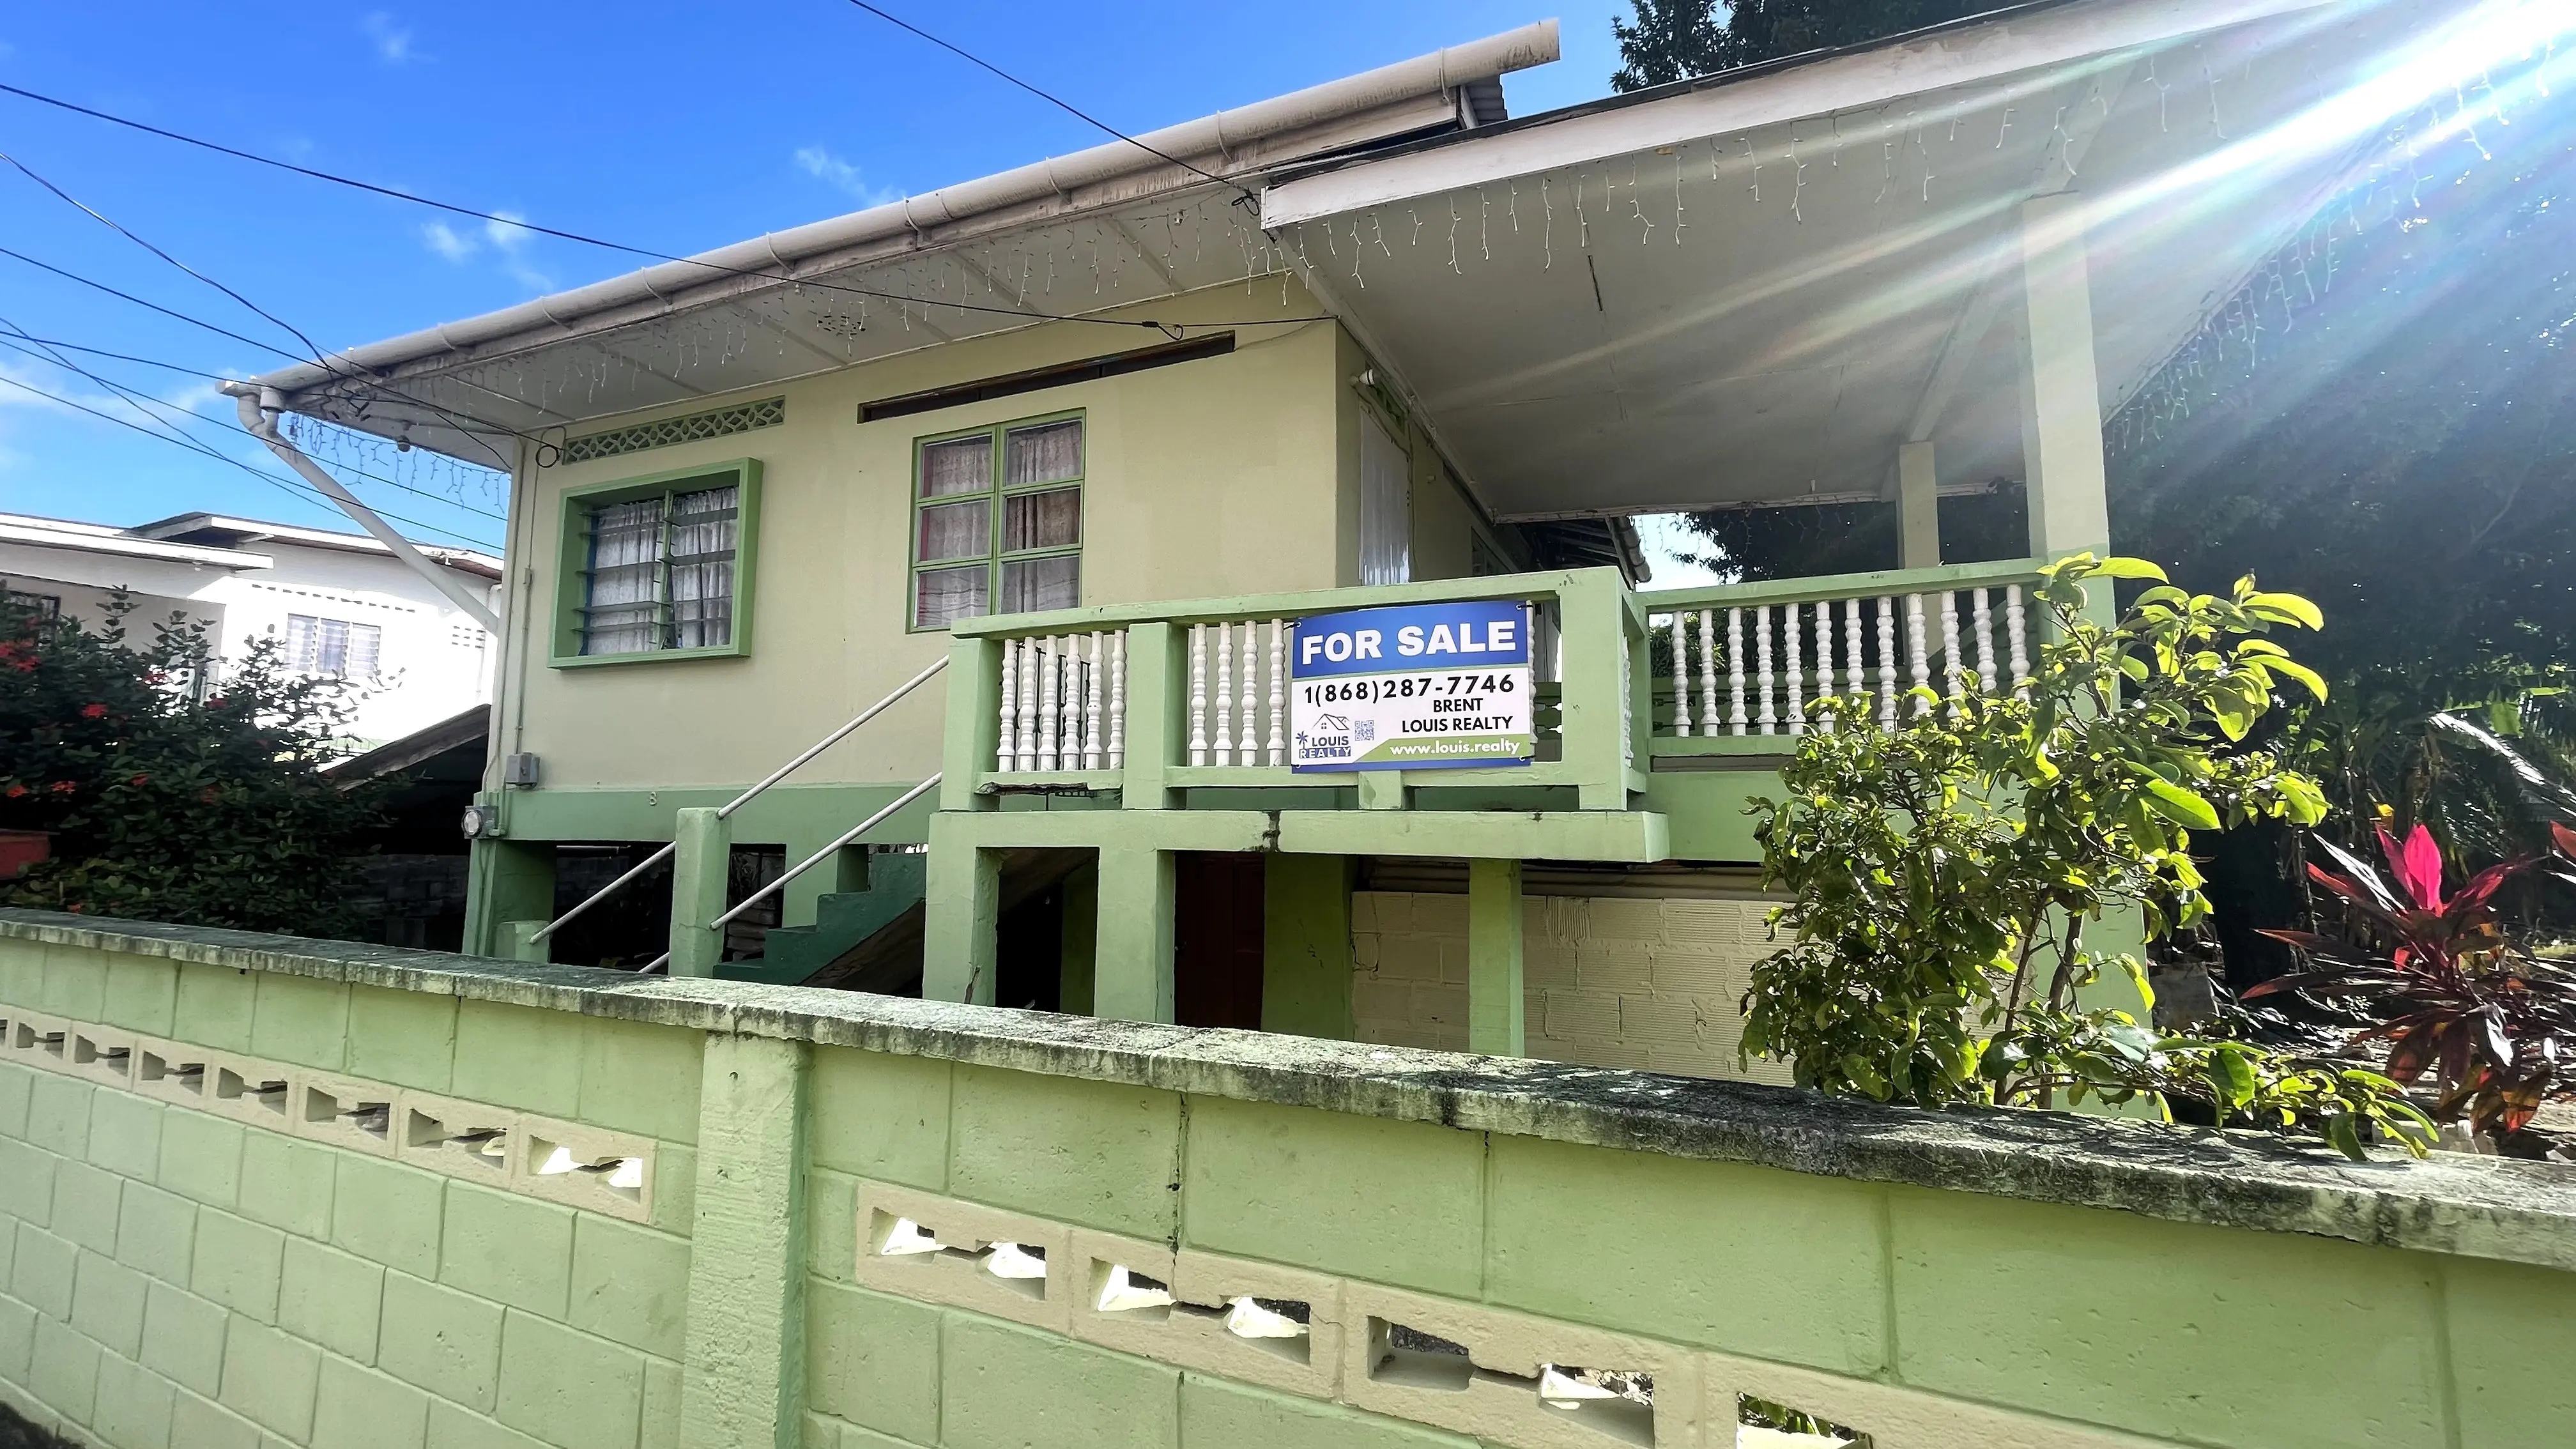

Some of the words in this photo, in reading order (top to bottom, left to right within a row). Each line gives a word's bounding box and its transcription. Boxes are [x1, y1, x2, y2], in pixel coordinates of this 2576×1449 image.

[1302, 630, 1382, 664] FOR
[1397, 621, 1516, 656] SALE
[1305, 675, 1514, 707] 1(868)287-7746
[1434, 698, 1483, 712] BRENT
[1402, 718, 1448, 733] LOUIS
[1453, 716, 1513, 731] REALTY
[1312, 736, 1349, 747] LOUIS
[1390, 739, 1520, 756] www.louis.realty
[1300, 746, 1351, 758] REALTY
